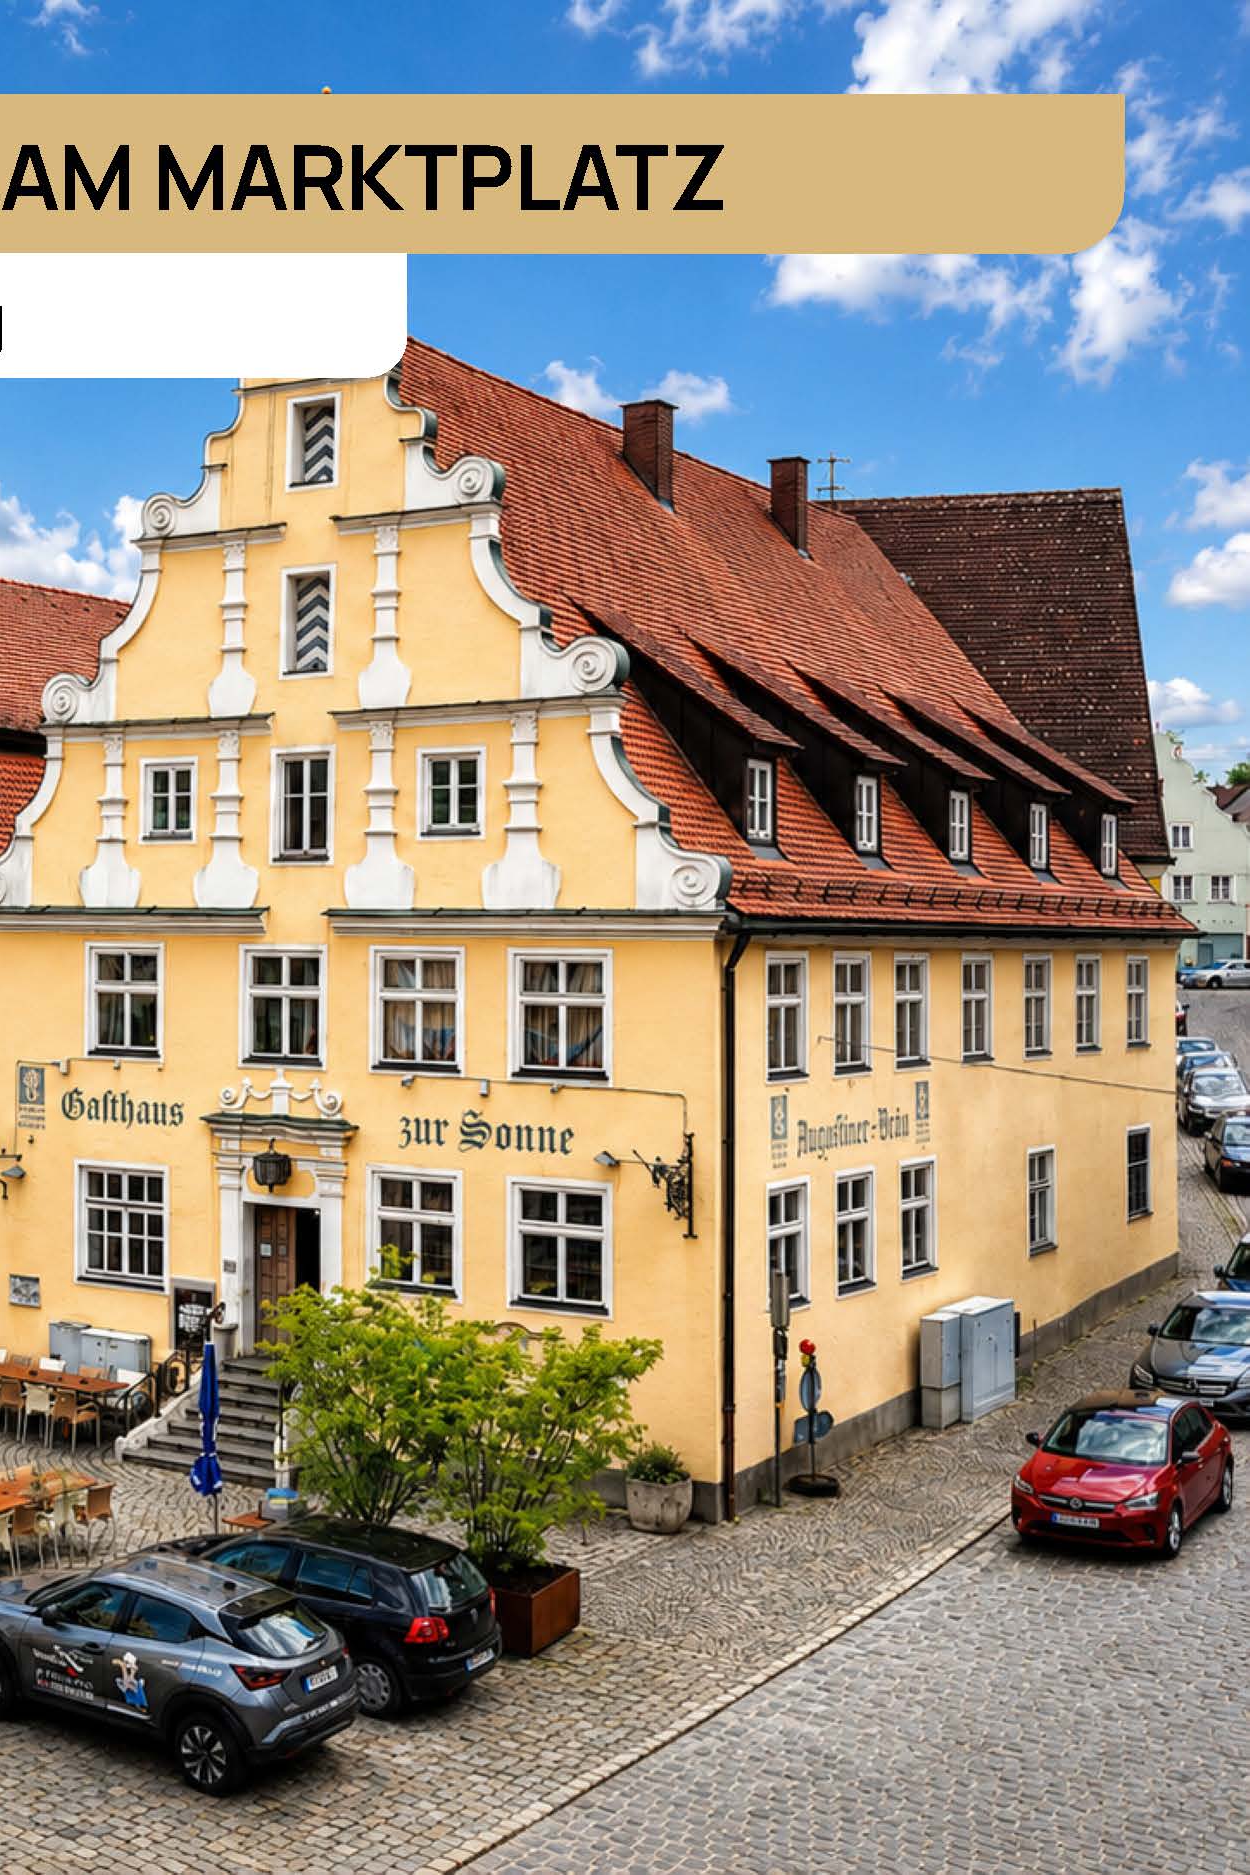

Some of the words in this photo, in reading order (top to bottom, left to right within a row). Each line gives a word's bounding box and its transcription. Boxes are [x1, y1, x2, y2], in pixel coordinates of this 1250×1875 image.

[61, 1087, 185, 1128] Gasthaus
[398, 1115, 450, 1149] zur
[457, 1108, 575, 1156] Sonne
